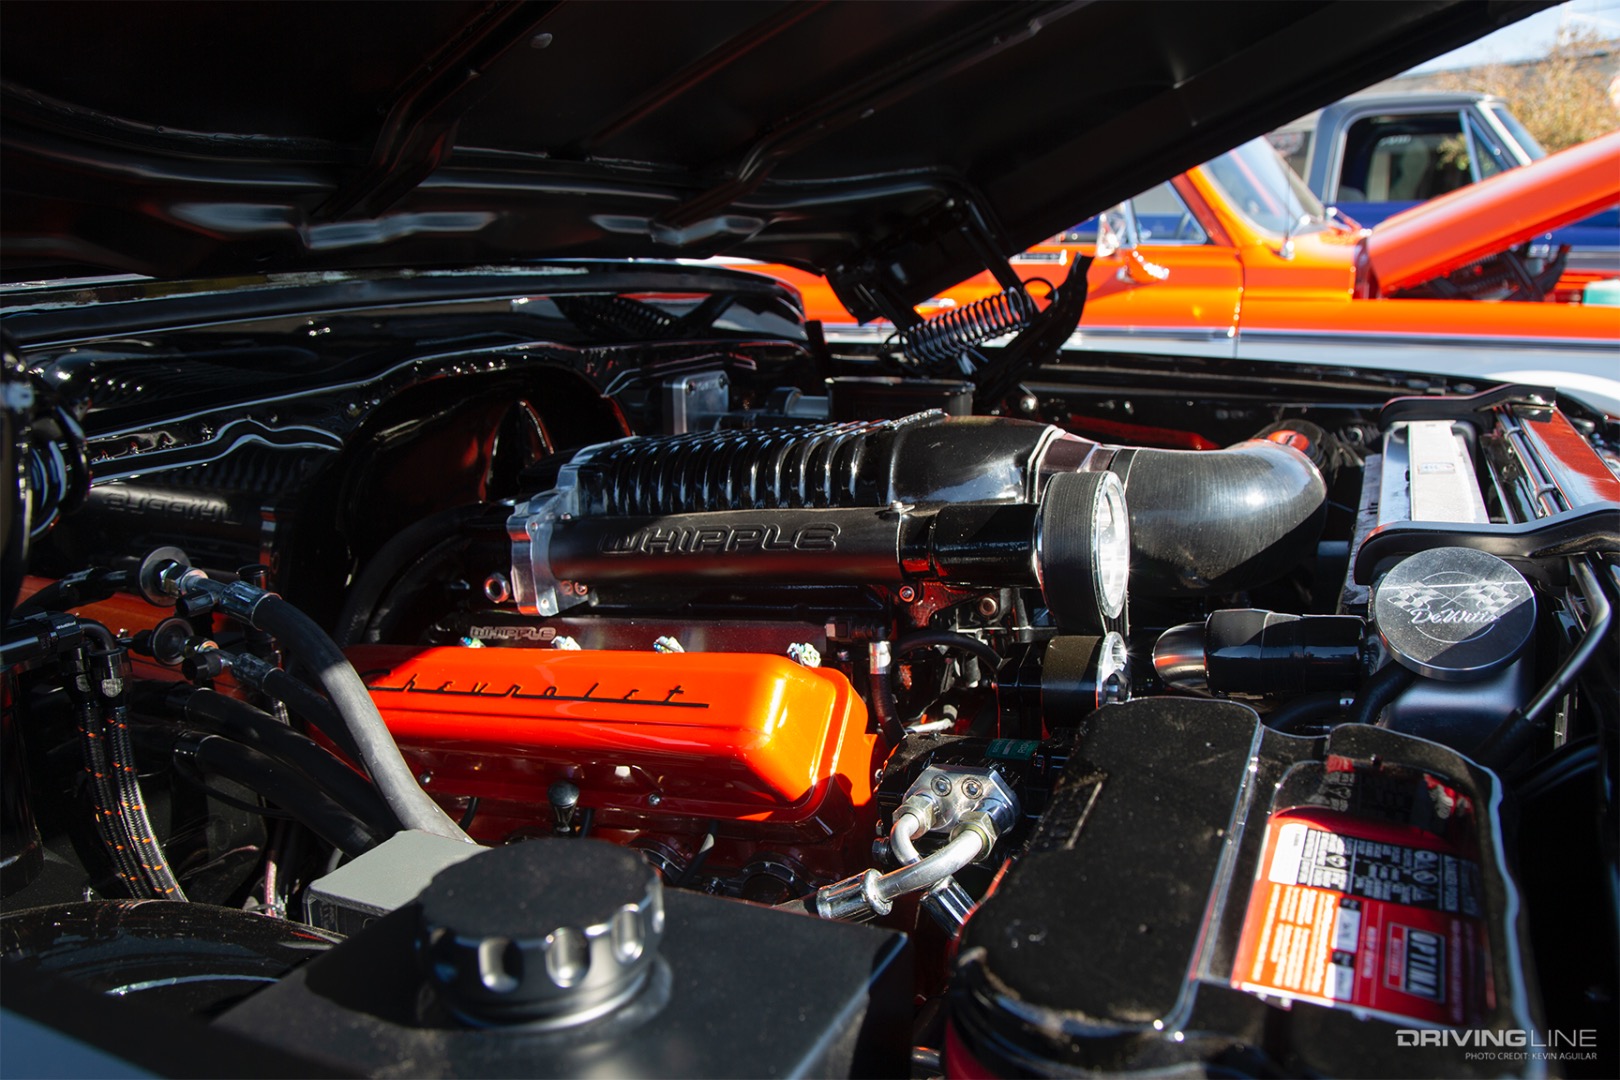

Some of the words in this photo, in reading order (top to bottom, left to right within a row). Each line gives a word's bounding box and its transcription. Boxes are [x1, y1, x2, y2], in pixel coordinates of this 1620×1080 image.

[598, 522, 841, 555] WHIPPLE
[470, 626, 557, 640] WHIPPLE
[1408, 931, 1438, 996] OPTIMA
